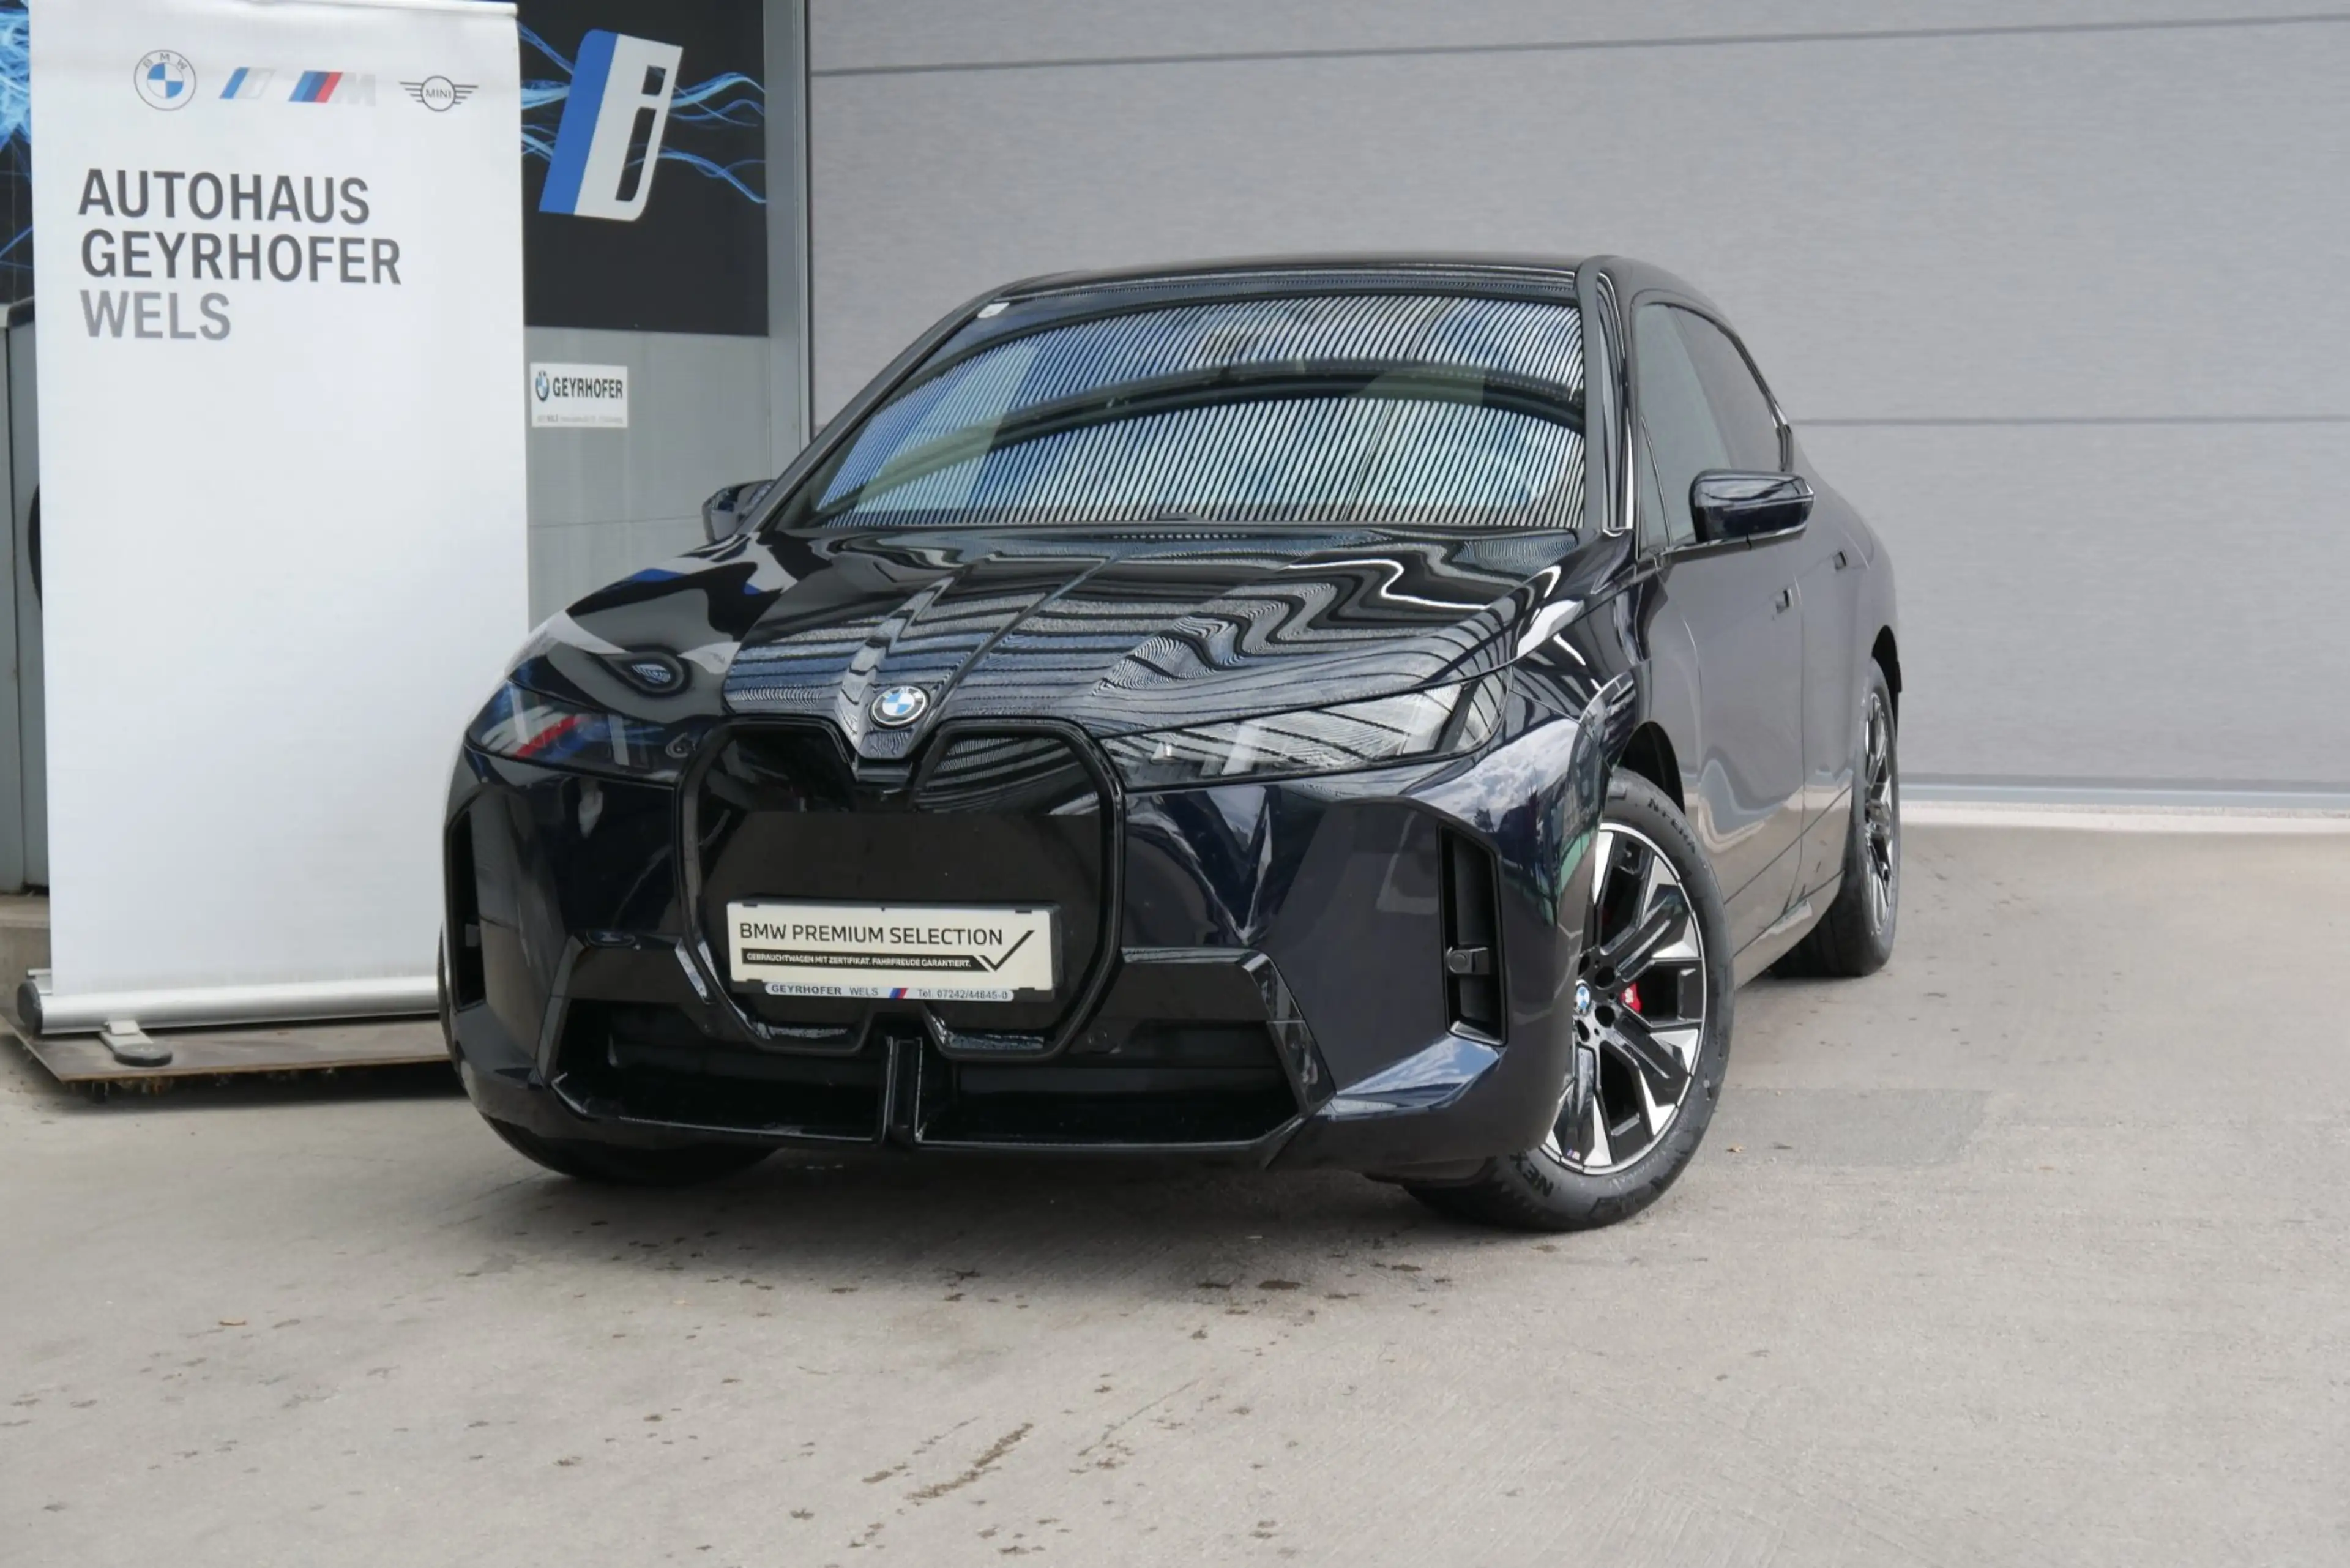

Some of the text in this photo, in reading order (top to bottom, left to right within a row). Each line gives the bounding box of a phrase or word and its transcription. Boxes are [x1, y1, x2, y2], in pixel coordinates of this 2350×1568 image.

[143, 53, 187, 69] BMW
[425, 87, 452, 99] MINI
[78, 168, 370, 224] AUTOHAUS
[81, 229, 401, 285] GEYRHOFER
[80, 289, 231, 341] WELS
[552, 376, 624, 399] GEYRHOFER
[739, 922, 1003, 946] BMW PREMIUM SELECTION
[771, 984, 842, 995] GEYRHOFER
[849, 987, 879, 996] WELS
